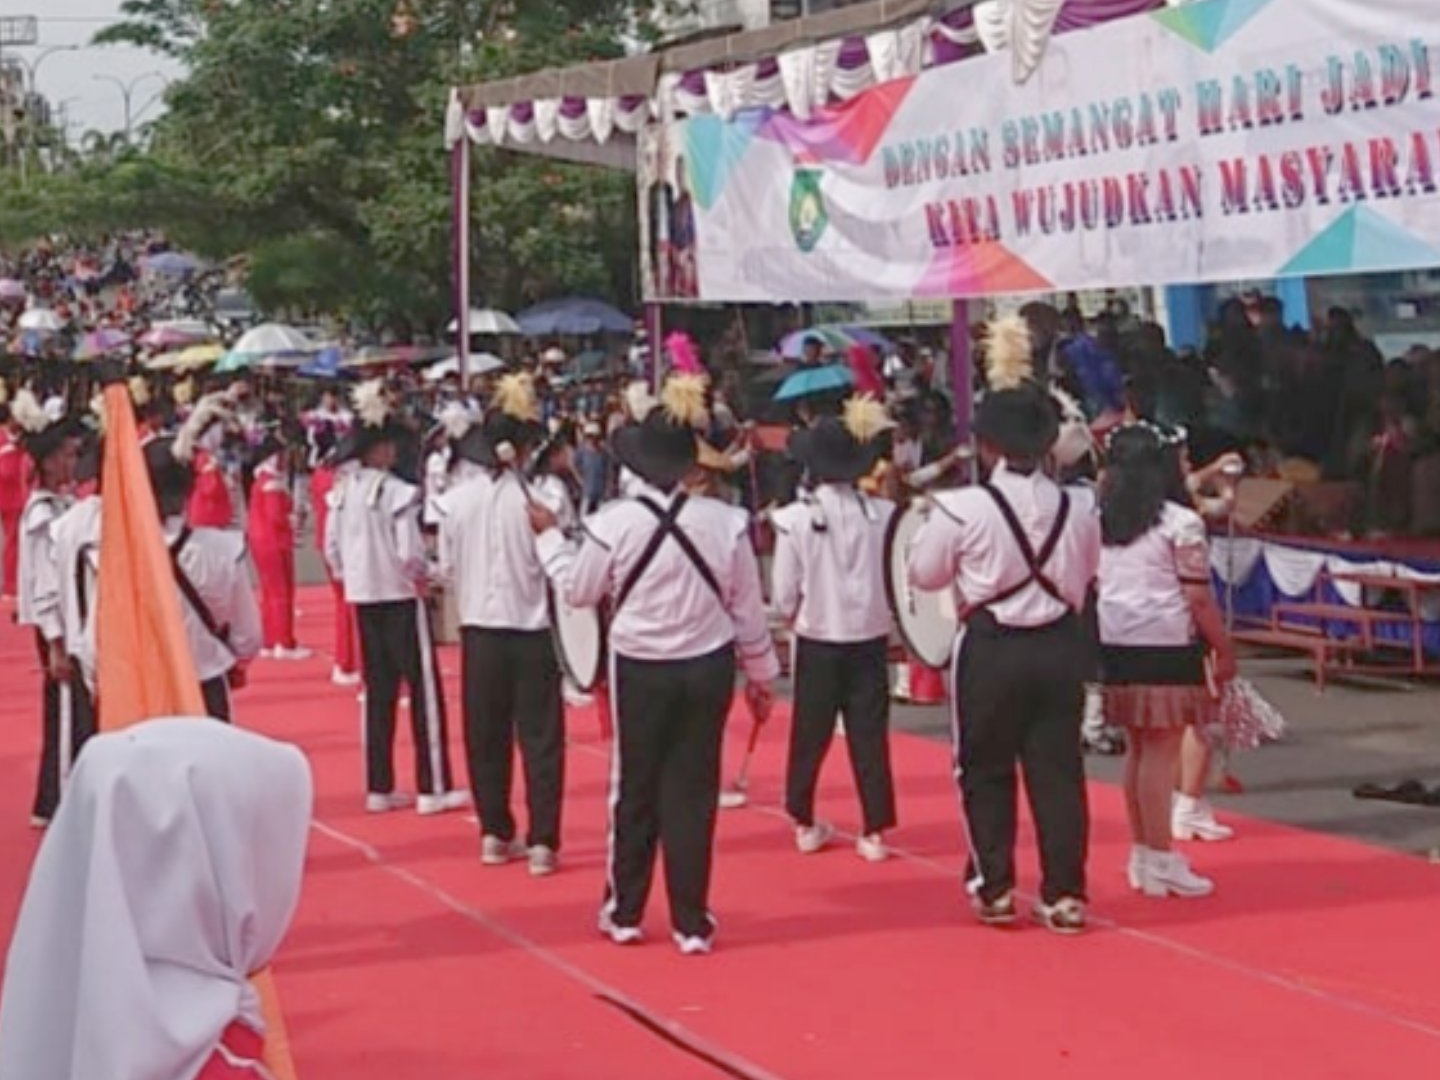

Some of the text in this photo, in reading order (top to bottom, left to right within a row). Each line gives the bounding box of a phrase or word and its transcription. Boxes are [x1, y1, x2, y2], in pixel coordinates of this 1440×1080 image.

[881, 38, 1433, 189] DENGAN SEMANGAT HARI JADI
[1012, 164, 1203, 237] WUJUDKAN
[1218, 128, 1440, 216] MASYARA
